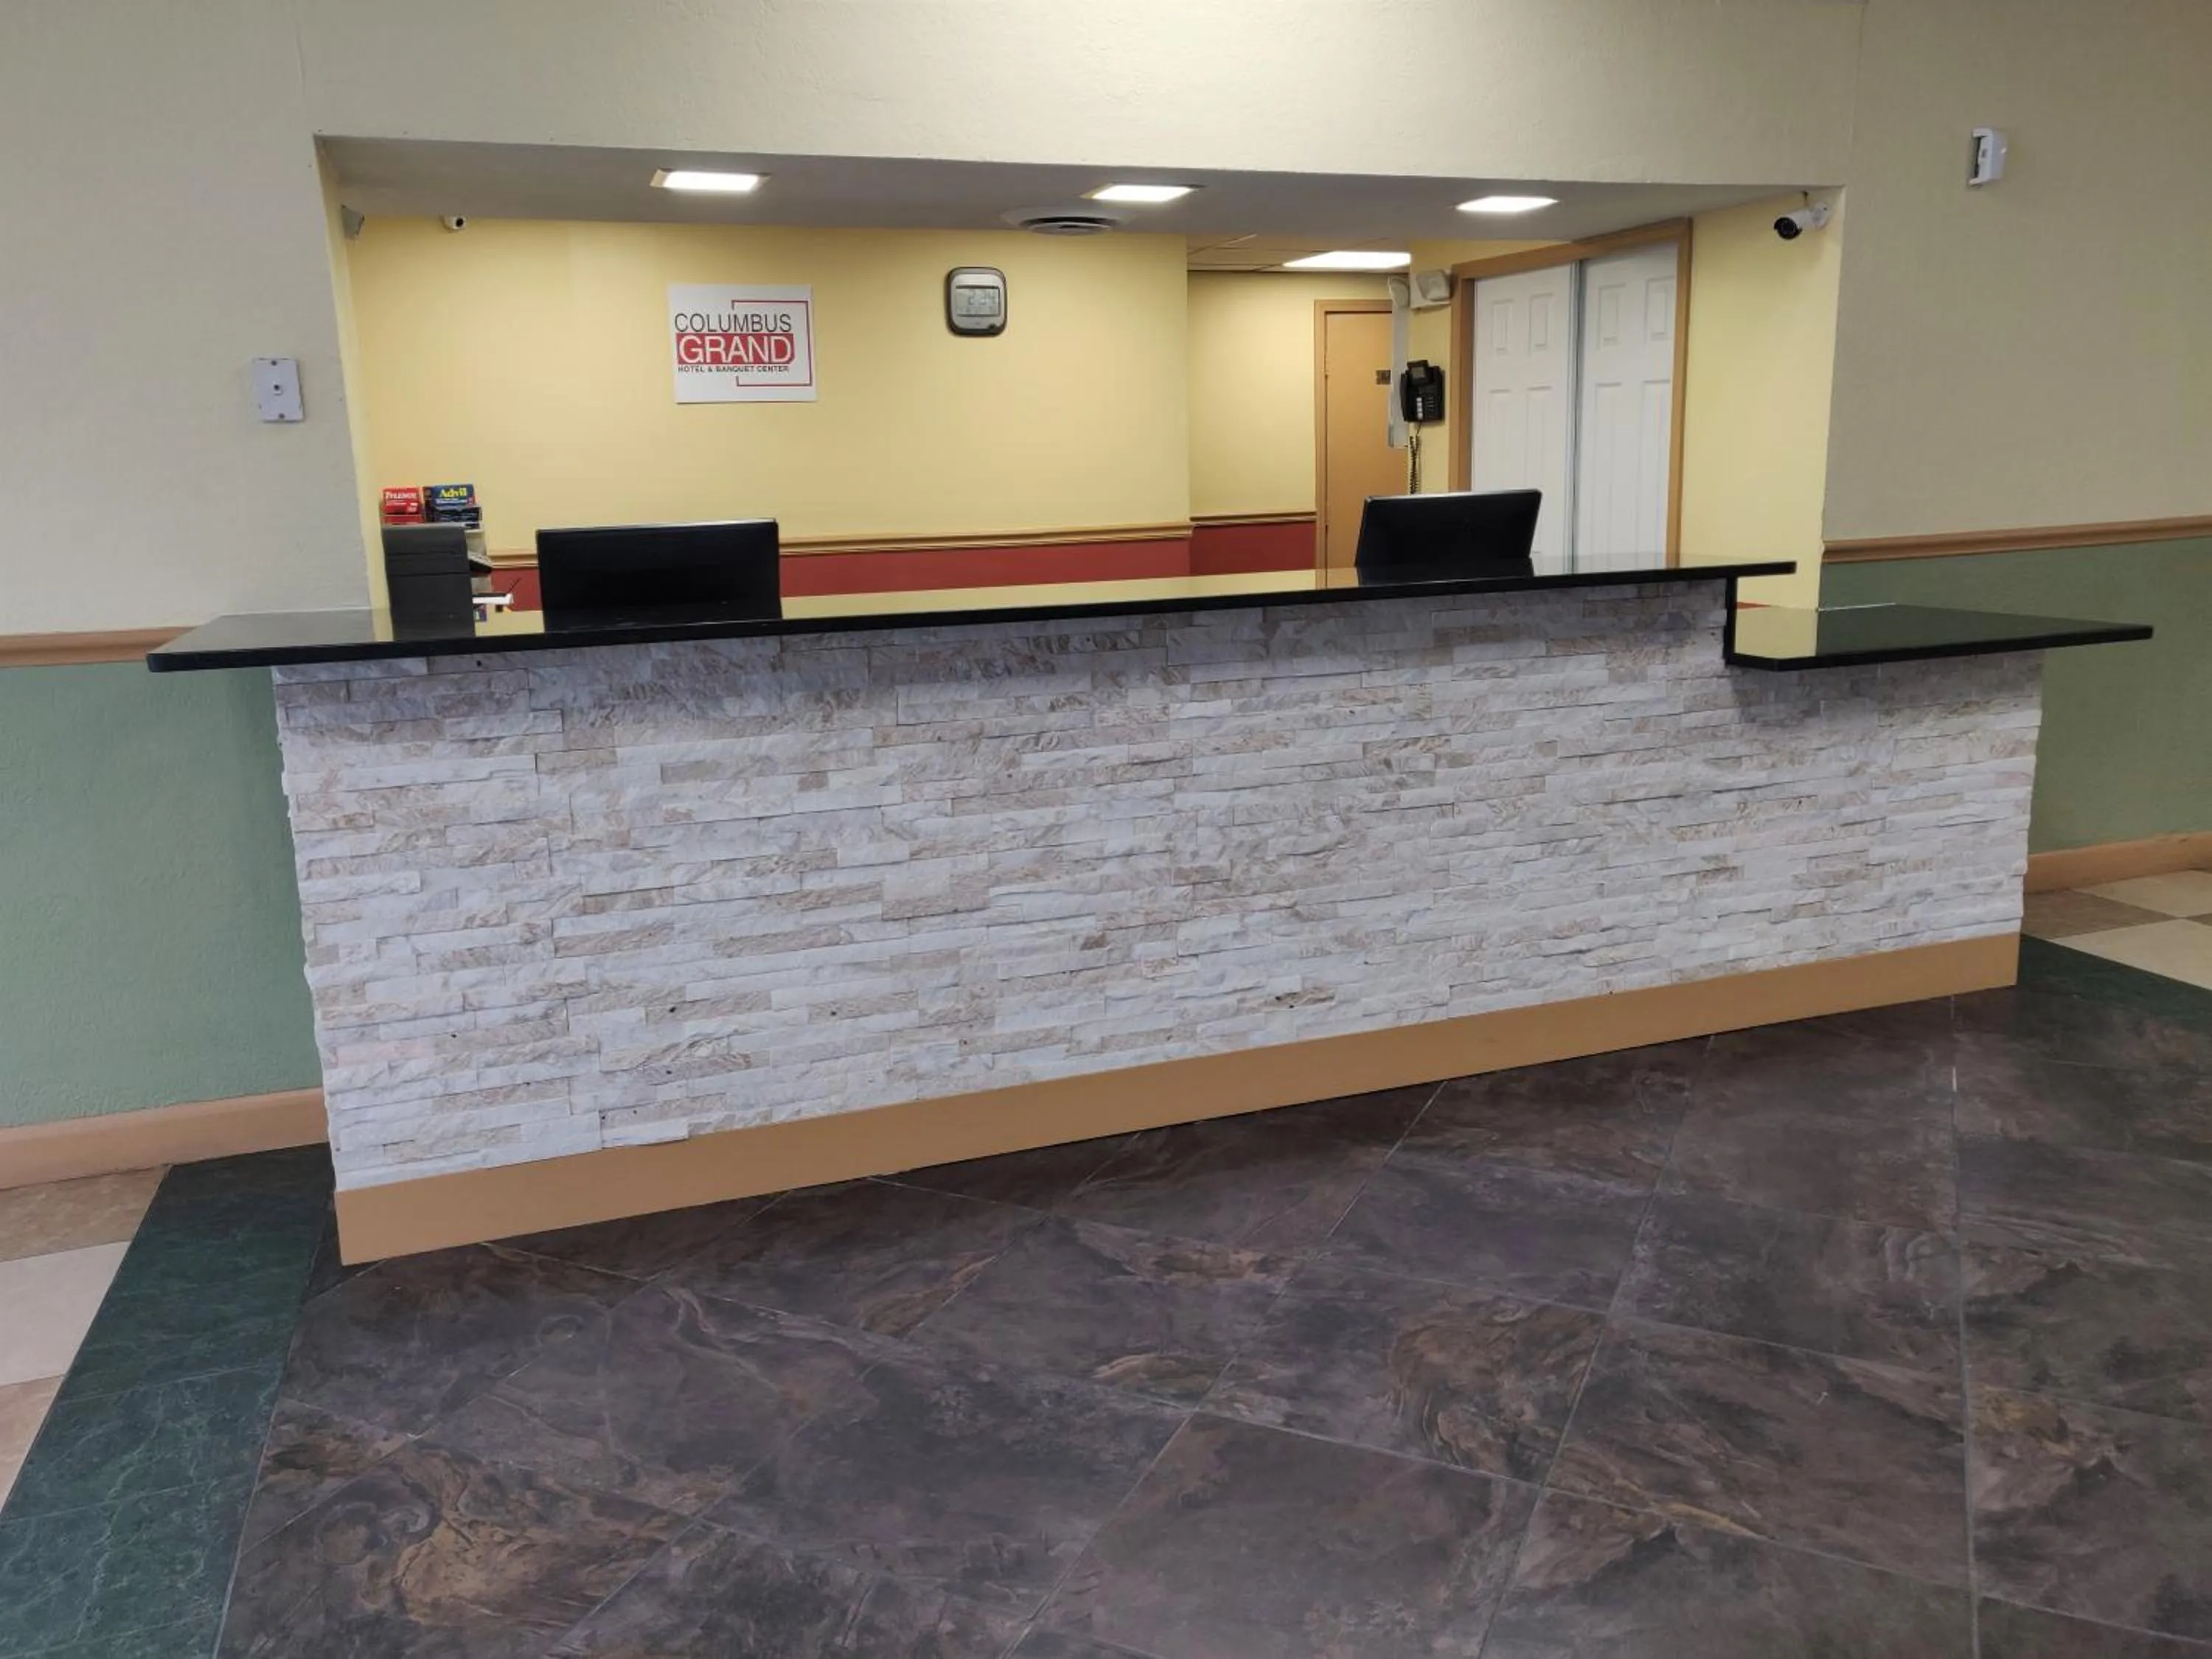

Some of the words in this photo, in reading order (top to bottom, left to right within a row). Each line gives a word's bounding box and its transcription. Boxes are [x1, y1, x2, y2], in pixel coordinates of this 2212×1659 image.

[675, 313, 791, 333] COLUMBUS
[678, 335, 791, 364] GRAND
[439, 487, 467, 498] Advil
